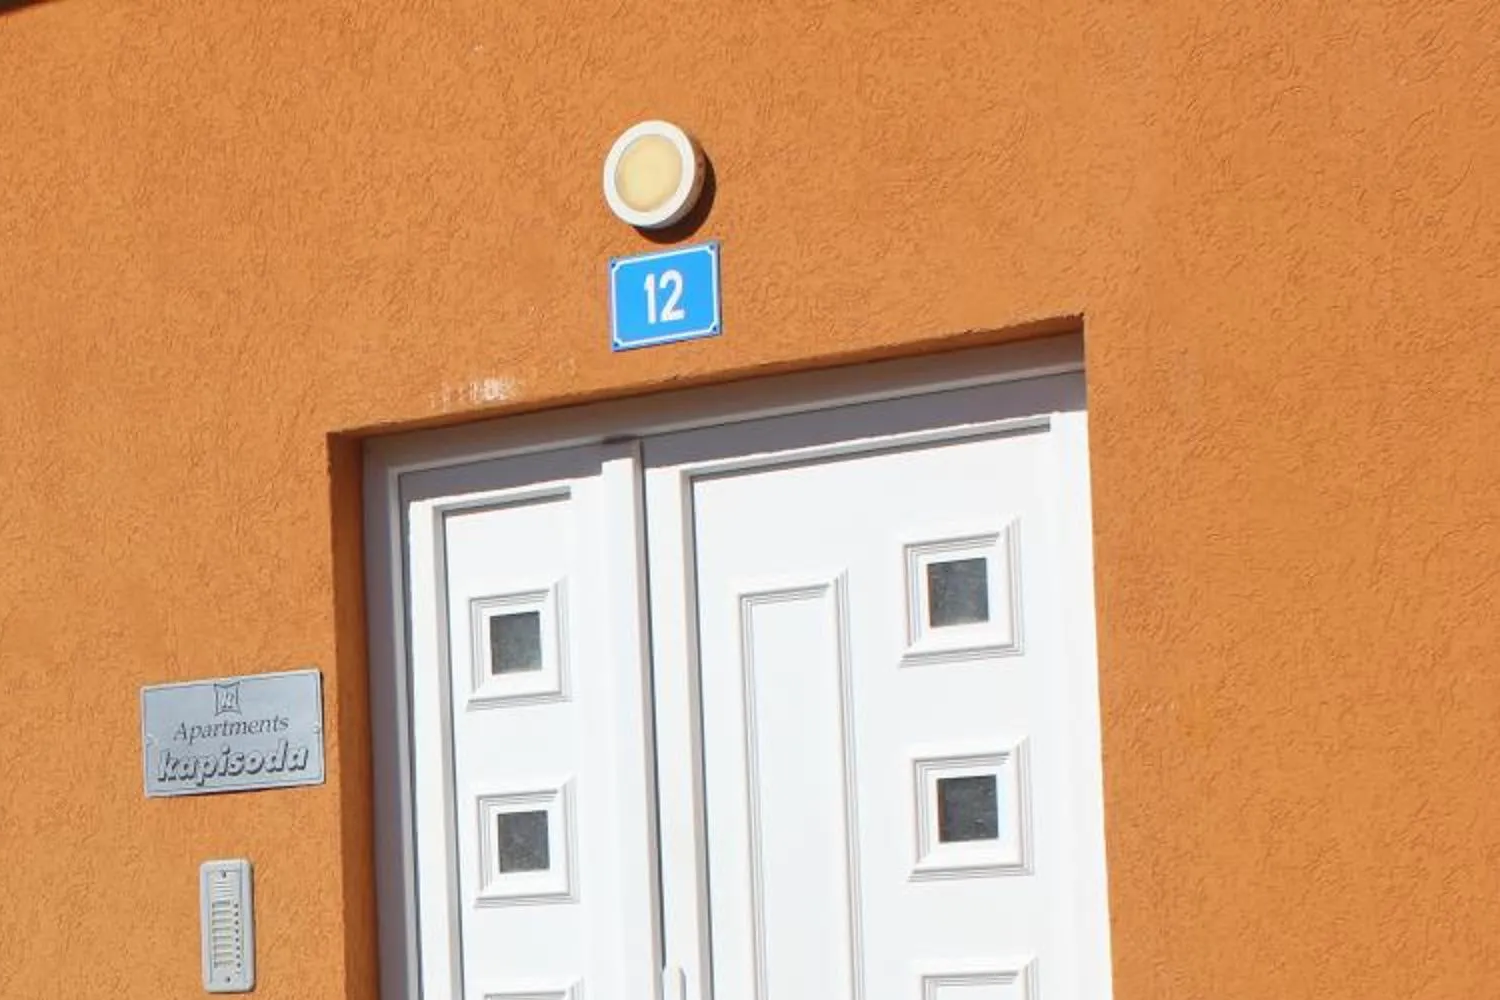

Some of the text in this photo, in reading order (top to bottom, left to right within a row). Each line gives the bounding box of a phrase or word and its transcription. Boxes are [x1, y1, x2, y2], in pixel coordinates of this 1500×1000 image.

[643, 269, 685, 325] 12
[173, 715, 289, 746] Apartments
[157, 739, 309, 786] kapisoda
